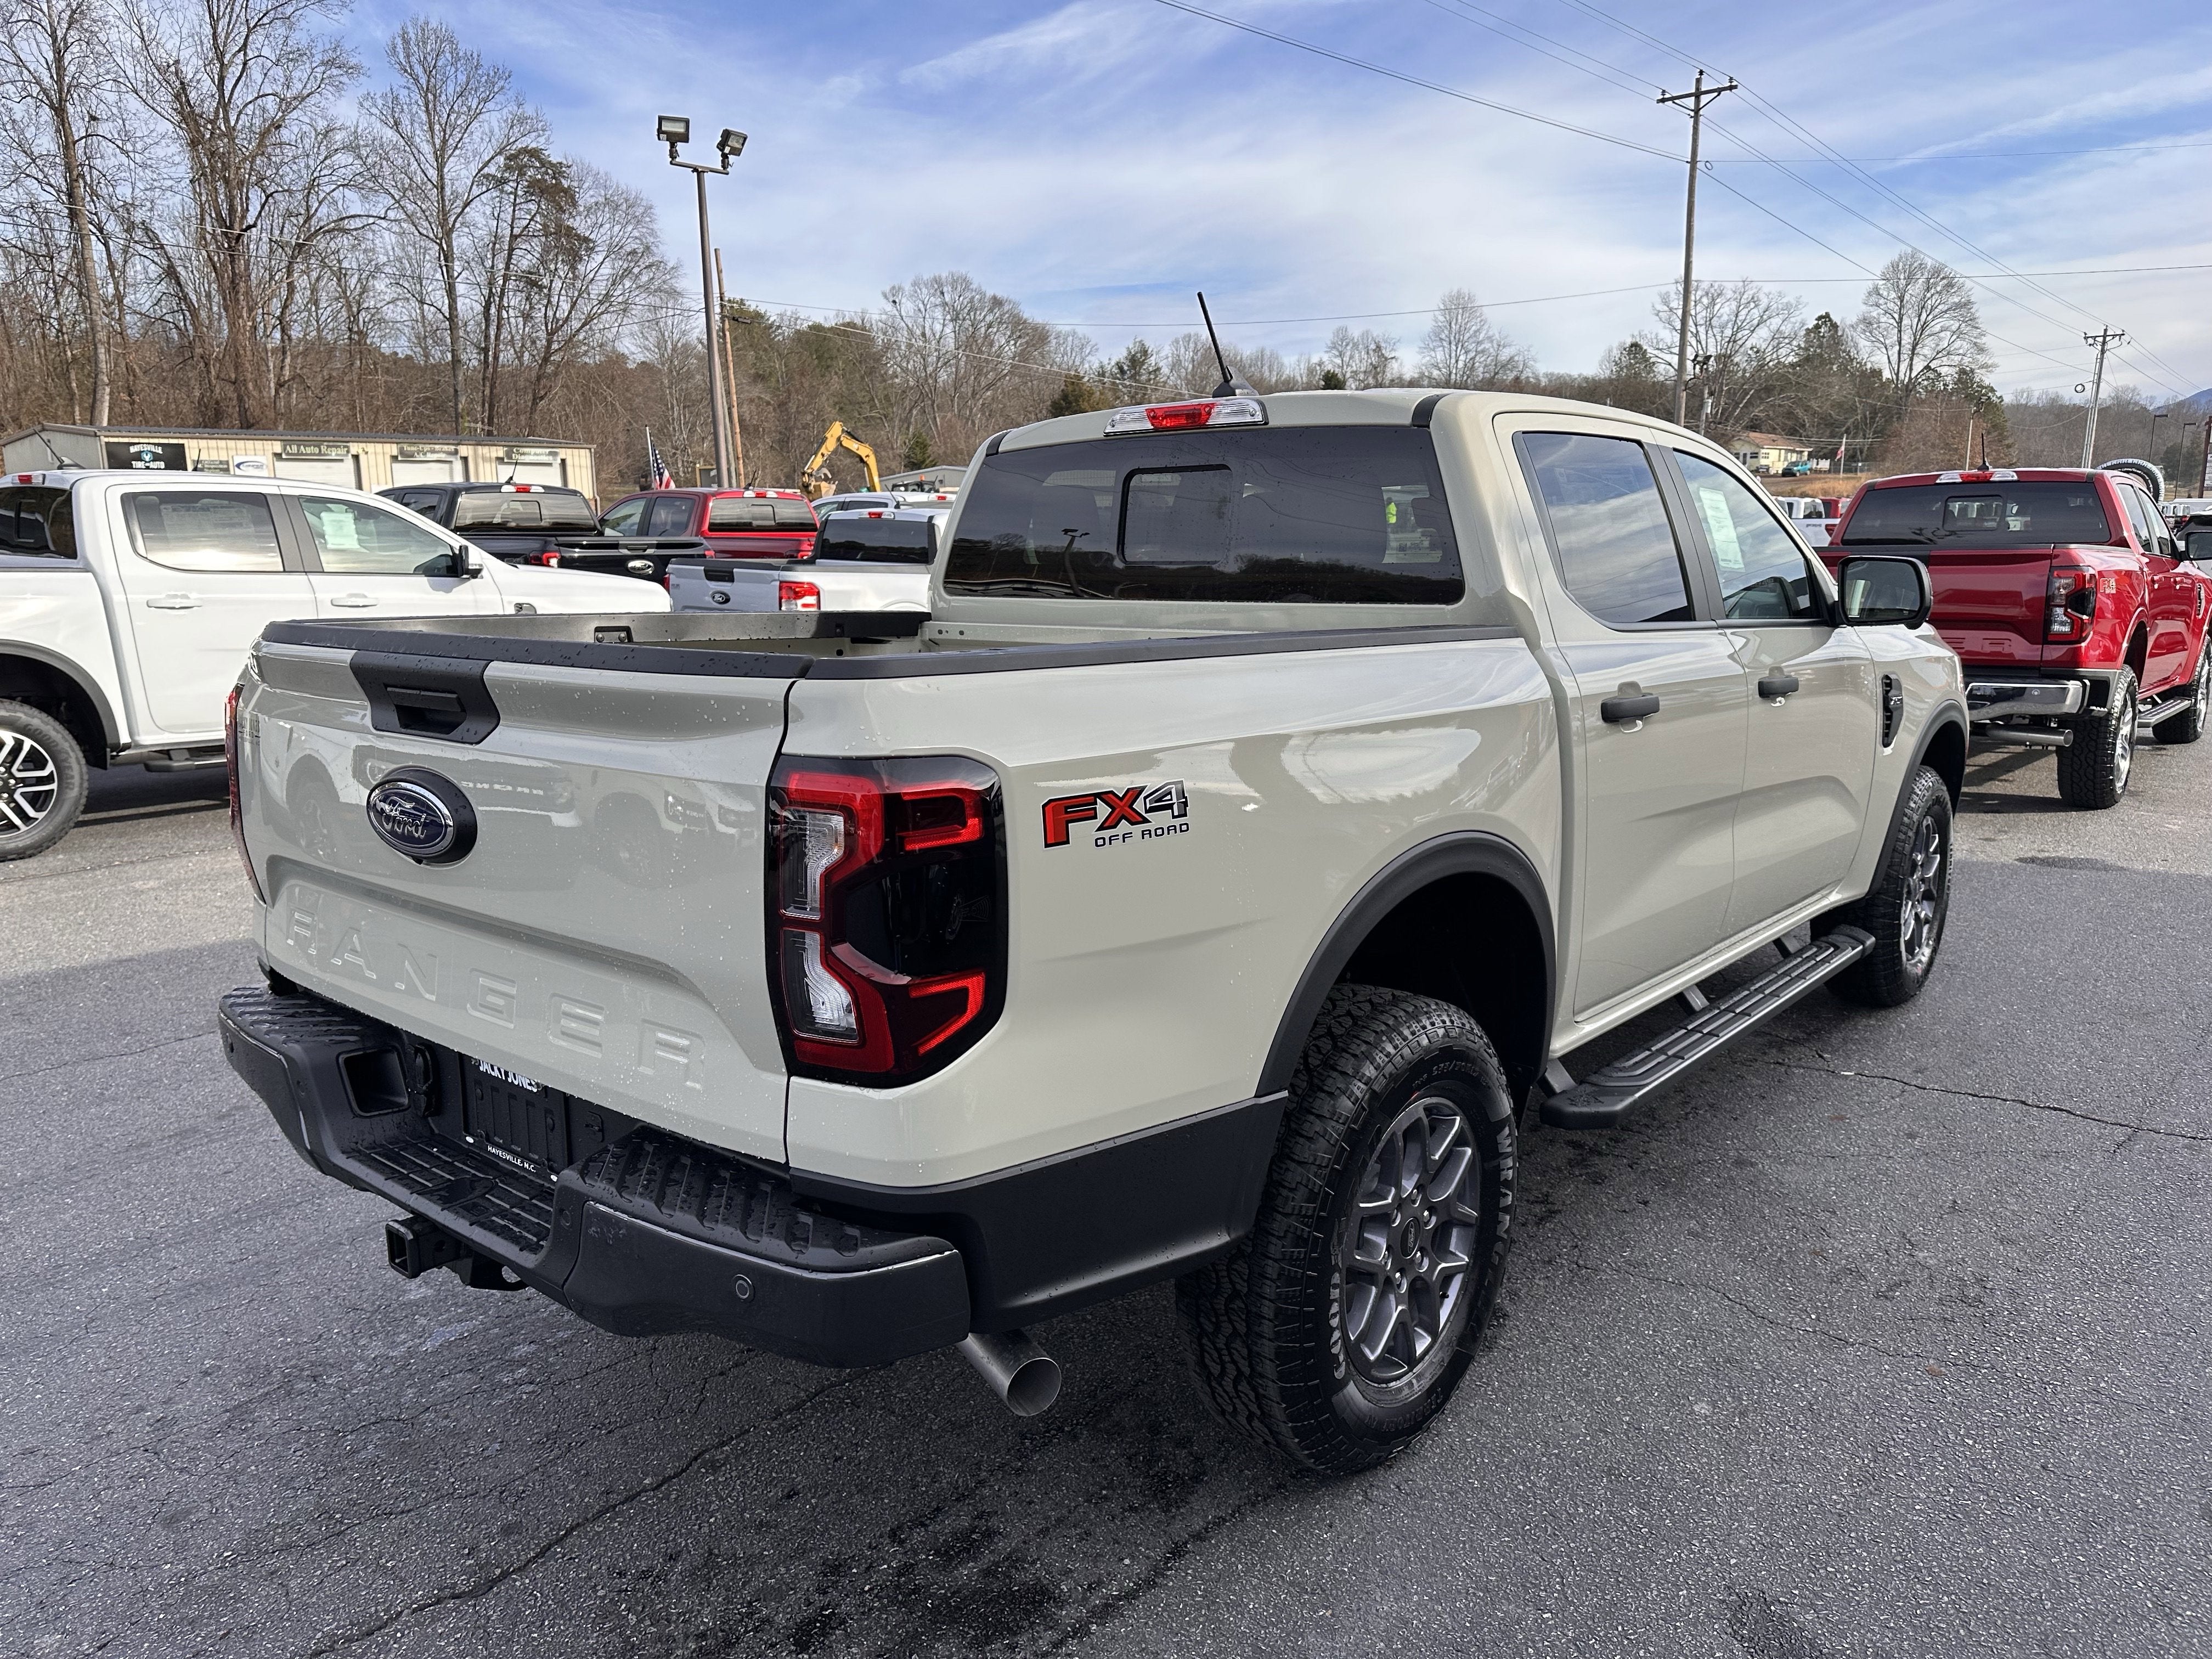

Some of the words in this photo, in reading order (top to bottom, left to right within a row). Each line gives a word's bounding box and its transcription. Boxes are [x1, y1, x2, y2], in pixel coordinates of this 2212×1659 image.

[129, 443, 163, 454] HAYESVILLE
[285, 444, 297, 453] All
[299, 445, 319, 454] Auto
[320, 445, 348, 456] Repair
[382, 796, 427, 839] Ford
[1041, 777, 1189, 849] FX4
[1094, 831, 1133, 848] OFF
[1141, 822, 1189, 840] ROAD
[286, 906, 705, 1091] RANGER
[479, 1059, 506, 1080] JACKY
[507, 1070, 538, 1092] JONES
[488, 1145, 523, 1166] HAYESVILLE,
[524, 1161, 536, 1173] N.C.
